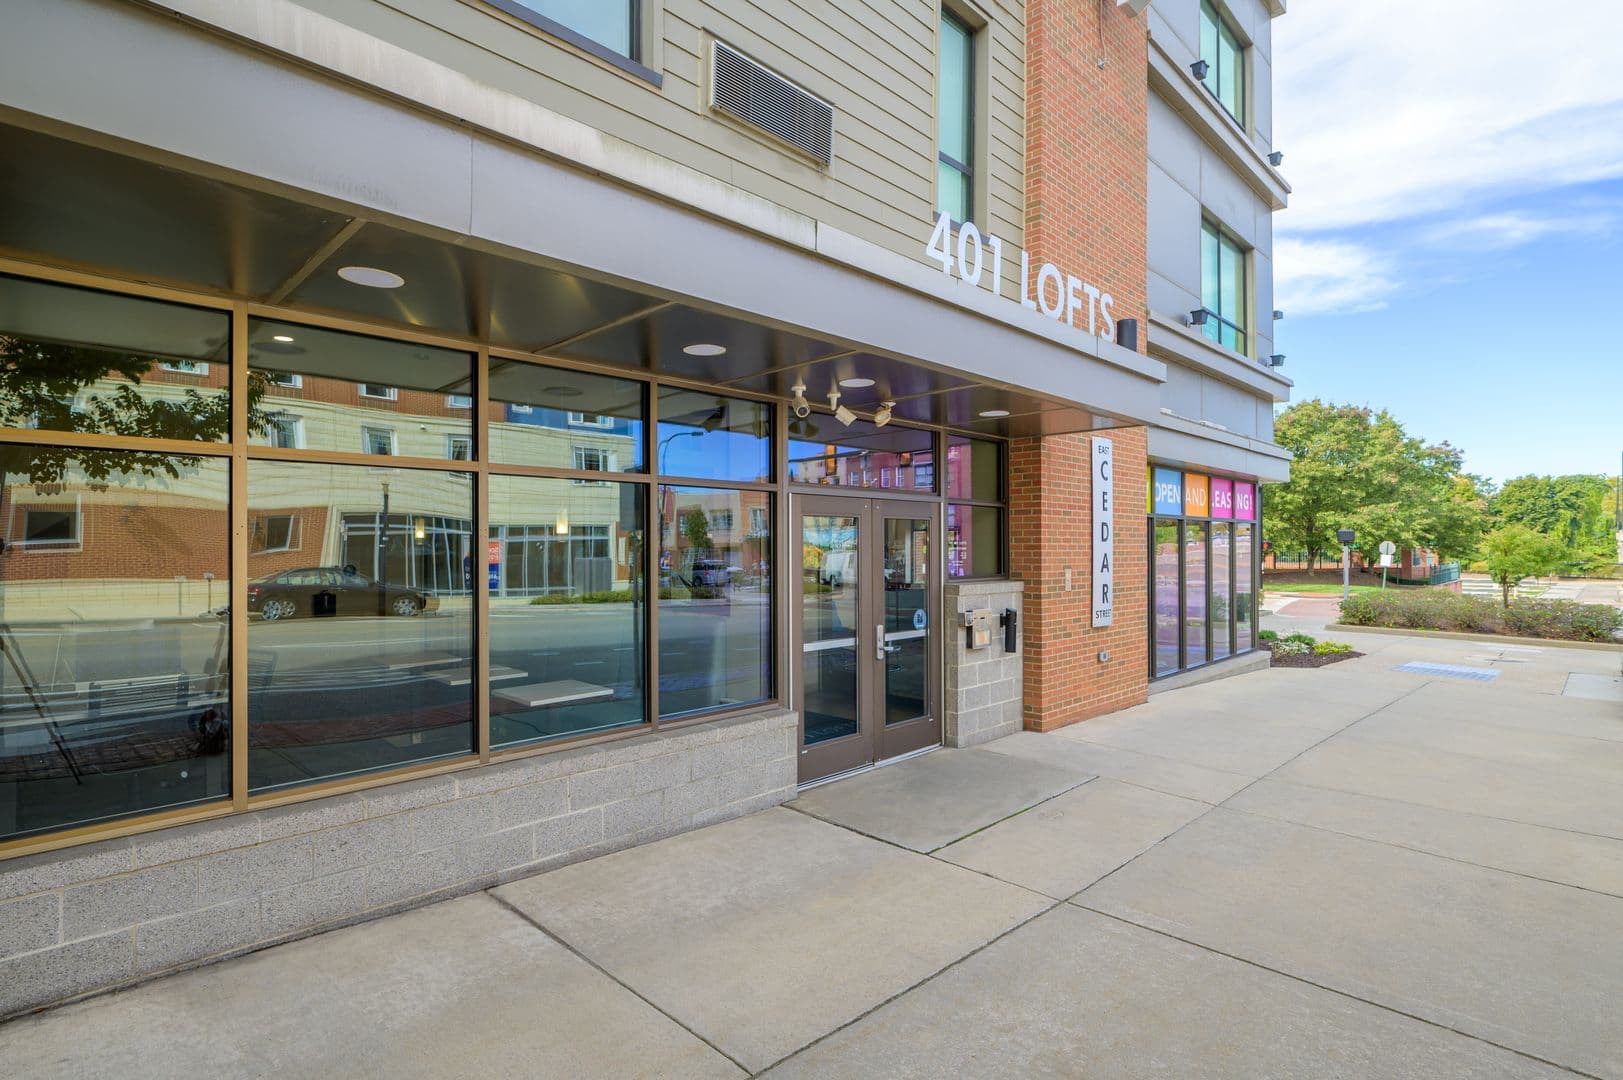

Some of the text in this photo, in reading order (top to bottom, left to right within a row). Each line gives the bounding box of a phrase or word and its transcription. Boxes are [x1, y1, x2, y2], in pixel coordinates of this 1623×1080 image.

[926, 210, 1115, 343] 401 LOFTS
[1100, 460, 1110, 604] CEDAR
[1155, 482, 1181, 504] OPEN
[1185, 487, 1207, 506] AND
[1211, 490, 1253, 511] EASNG!
[1095, 608, 1112, 619] STREET
